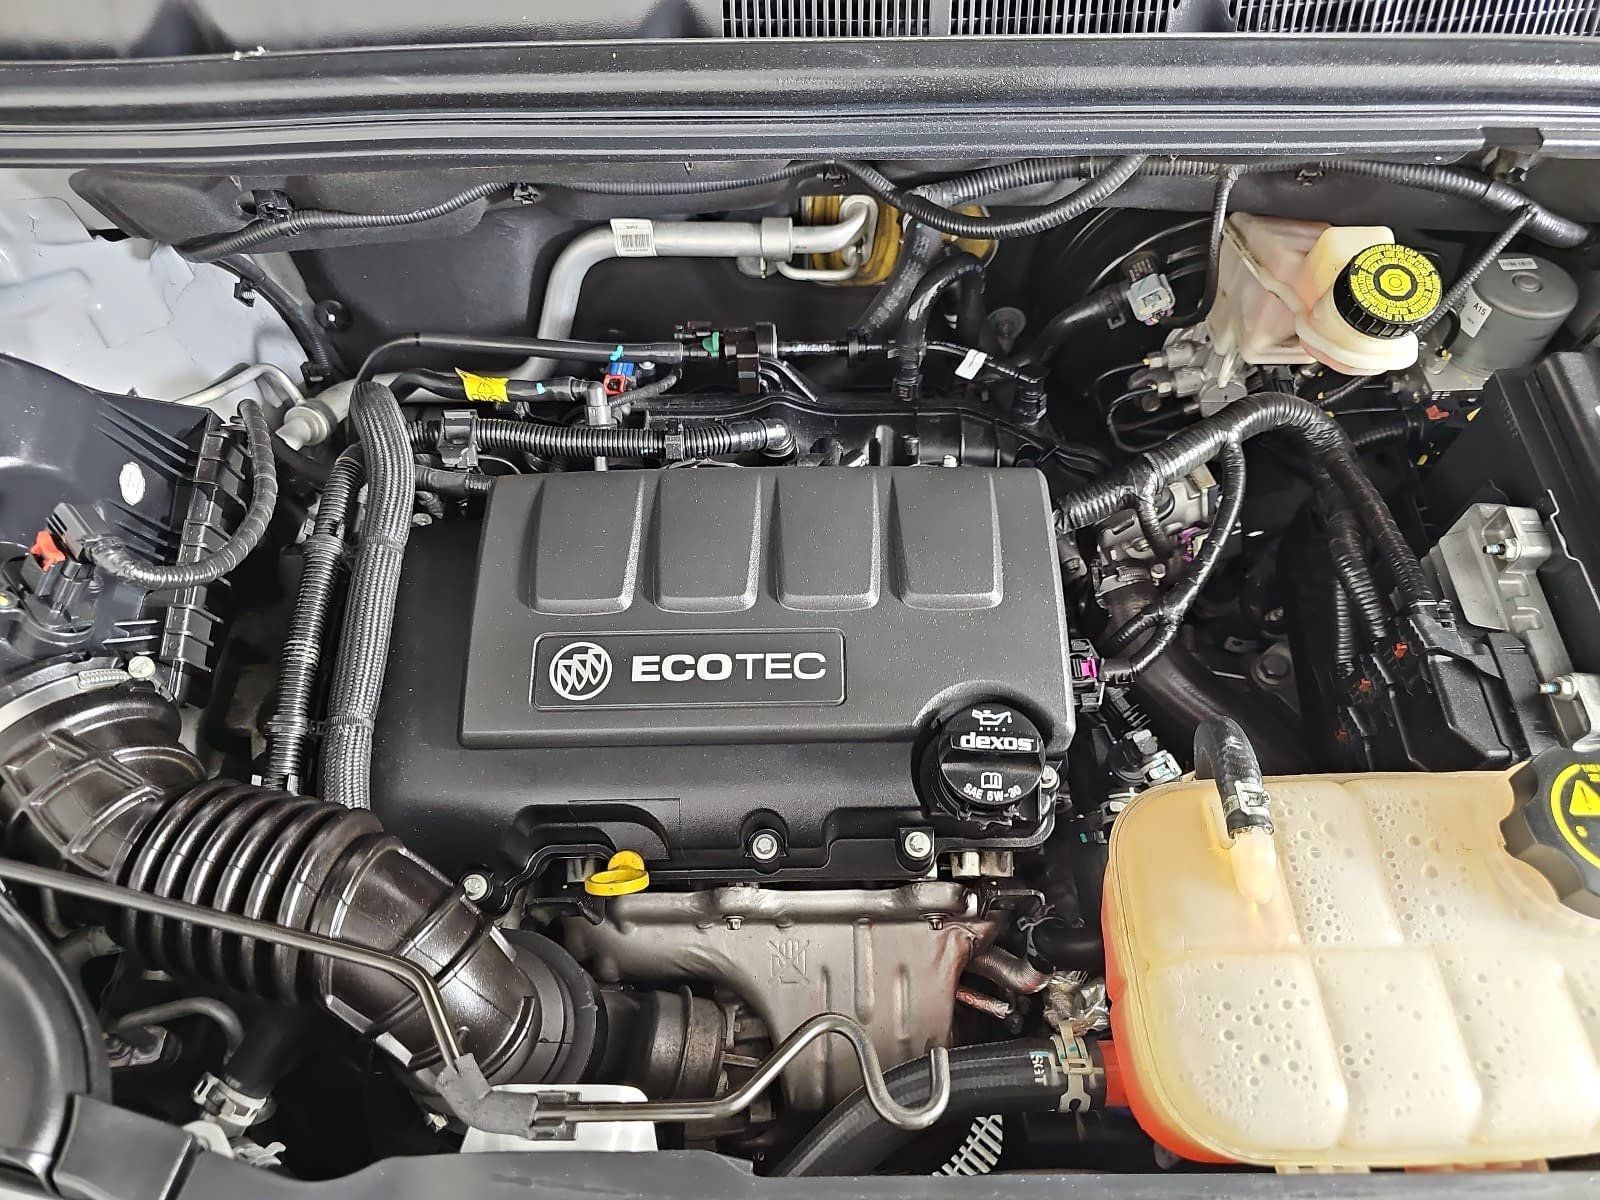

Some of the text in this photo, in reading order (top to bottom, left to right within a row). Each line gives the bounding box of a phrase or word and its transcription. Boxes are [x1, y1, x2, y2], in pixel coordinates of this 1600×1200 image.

[1473, 302, 1487, 316] A15
[631, 652, 826, 682] ECOTEC
[960, 732, 1034, 751] dexos
[963, 783, 983, 800] SAE
